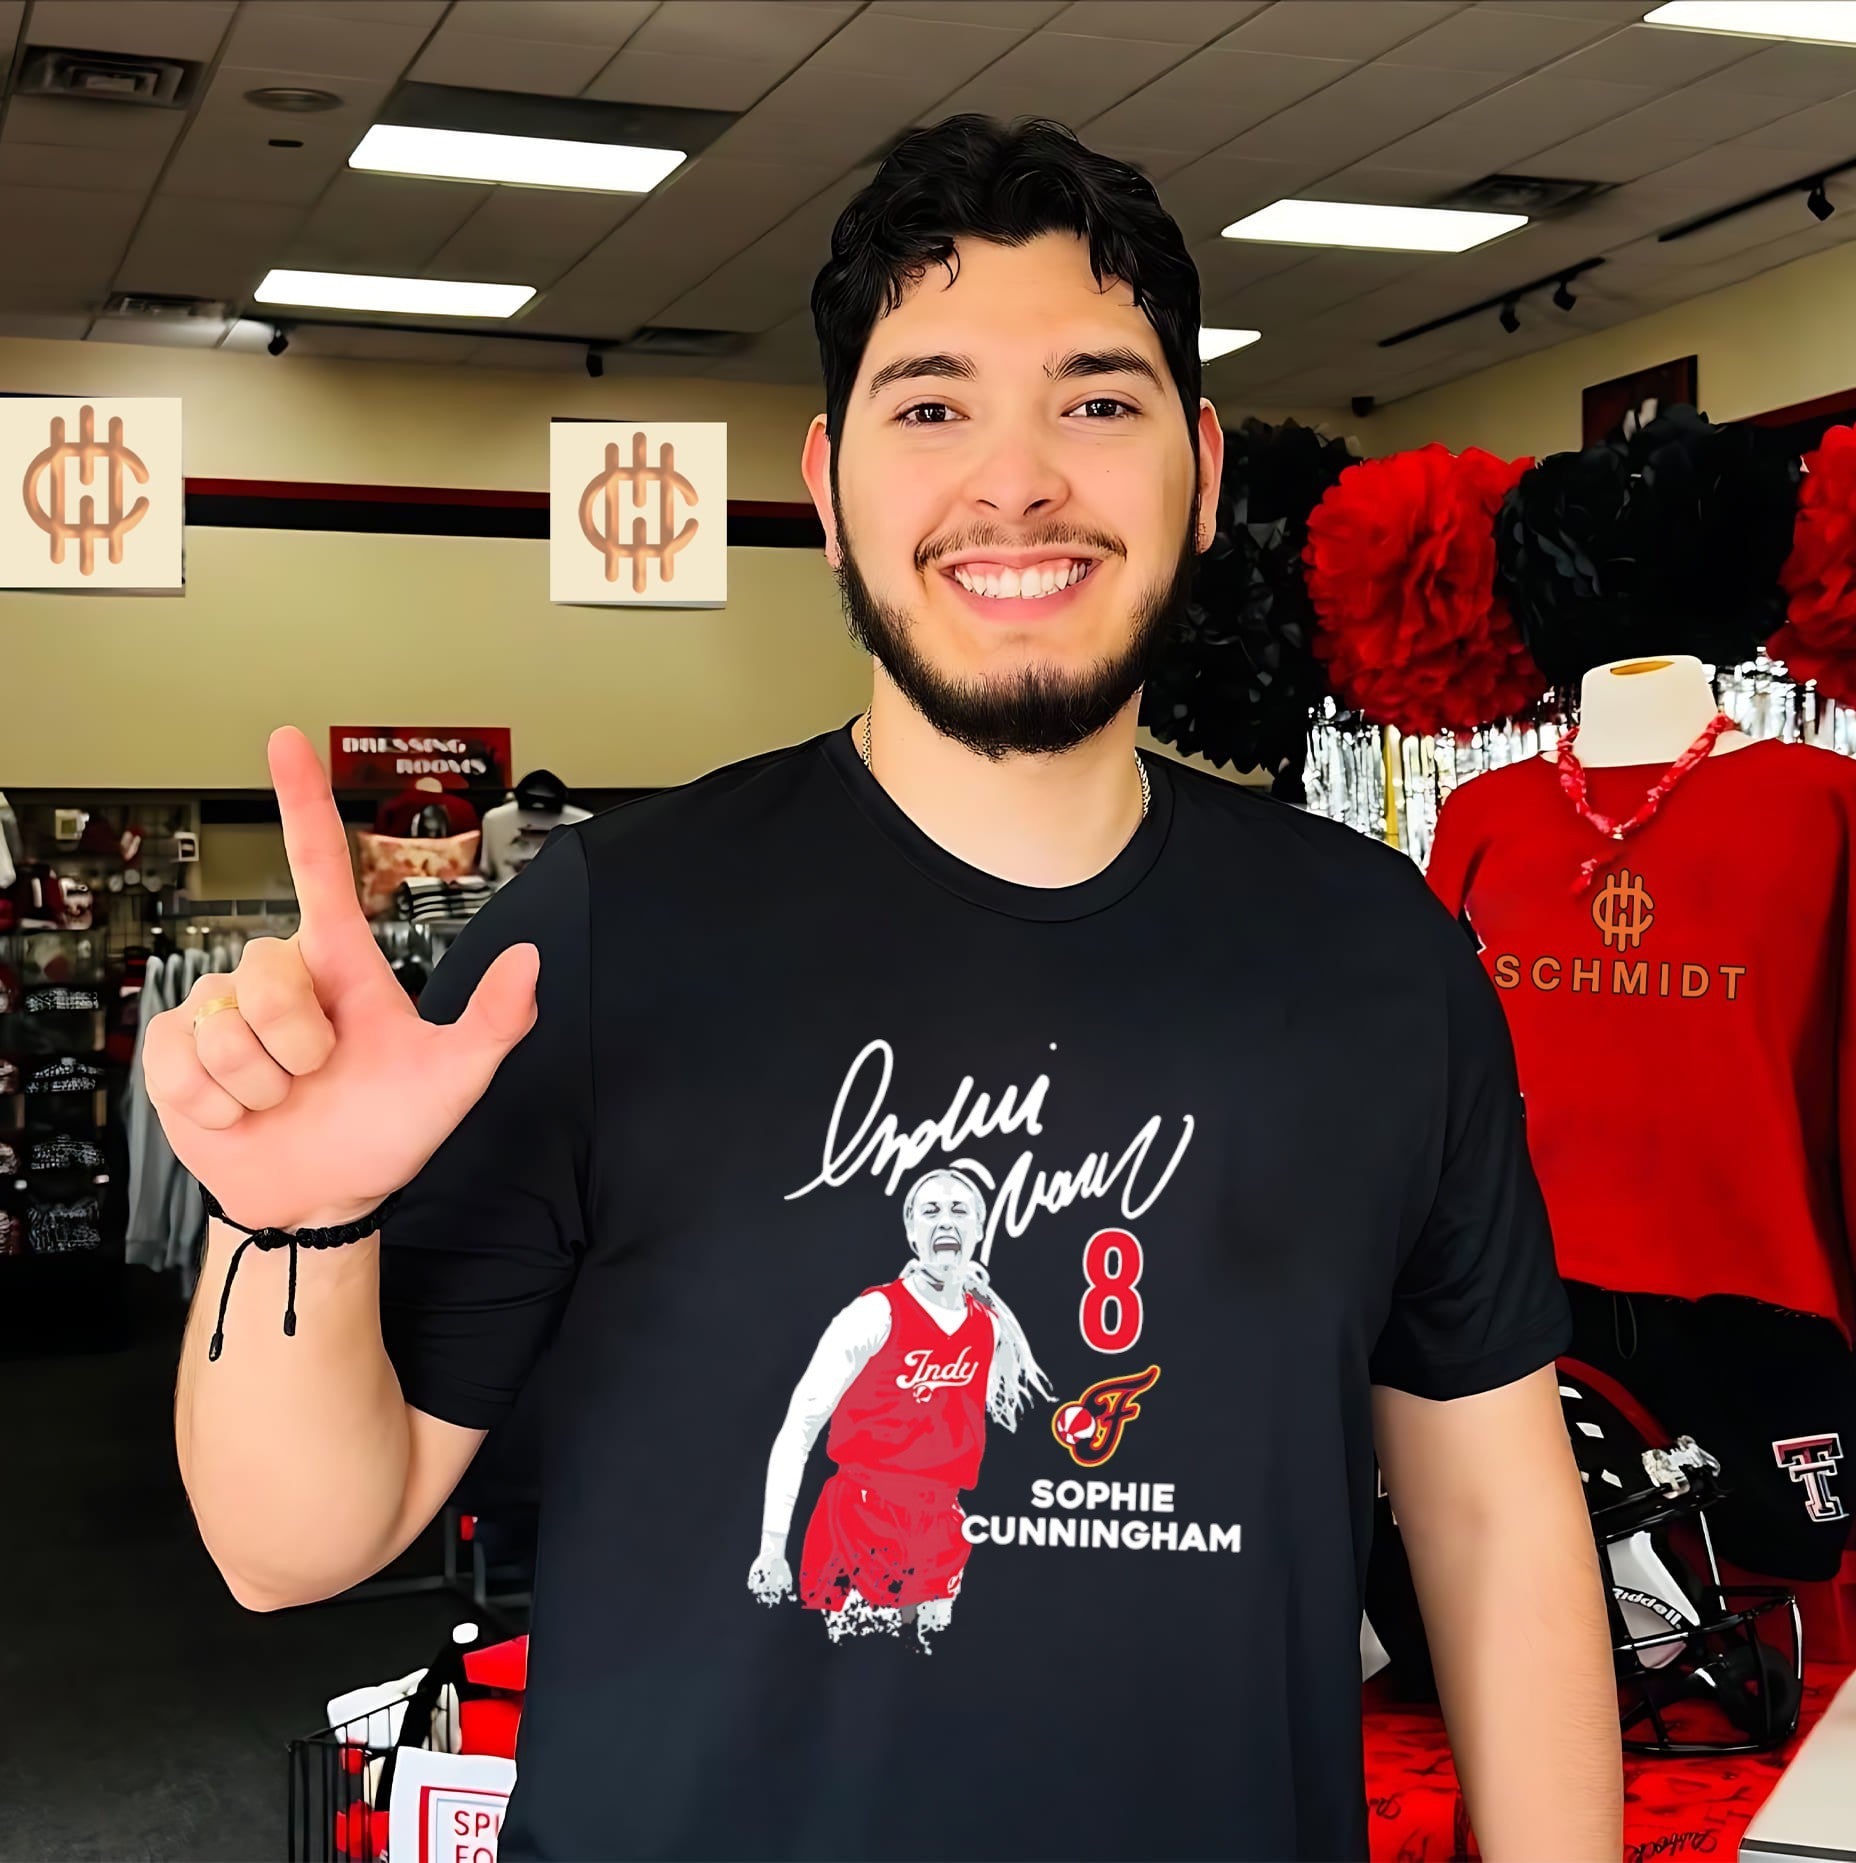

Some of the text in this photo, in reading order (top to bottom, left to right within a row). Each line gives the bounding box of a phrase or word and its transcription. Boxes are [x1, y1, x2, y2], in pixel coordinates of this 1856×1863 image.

[342, 737, 467, 754] DRESSING
[396, 758, 487, 774] ROOMS
[1493, 953, 1748, 1001] SCHMIDT
[1080, 1227, 1143, 1354] 8
[896, 1346, 979, 1389] Indy
[1030, 1478, 1176, 1513] SOPHIE
[960, 1514, 1242, 1553] CUNNINGHAM
